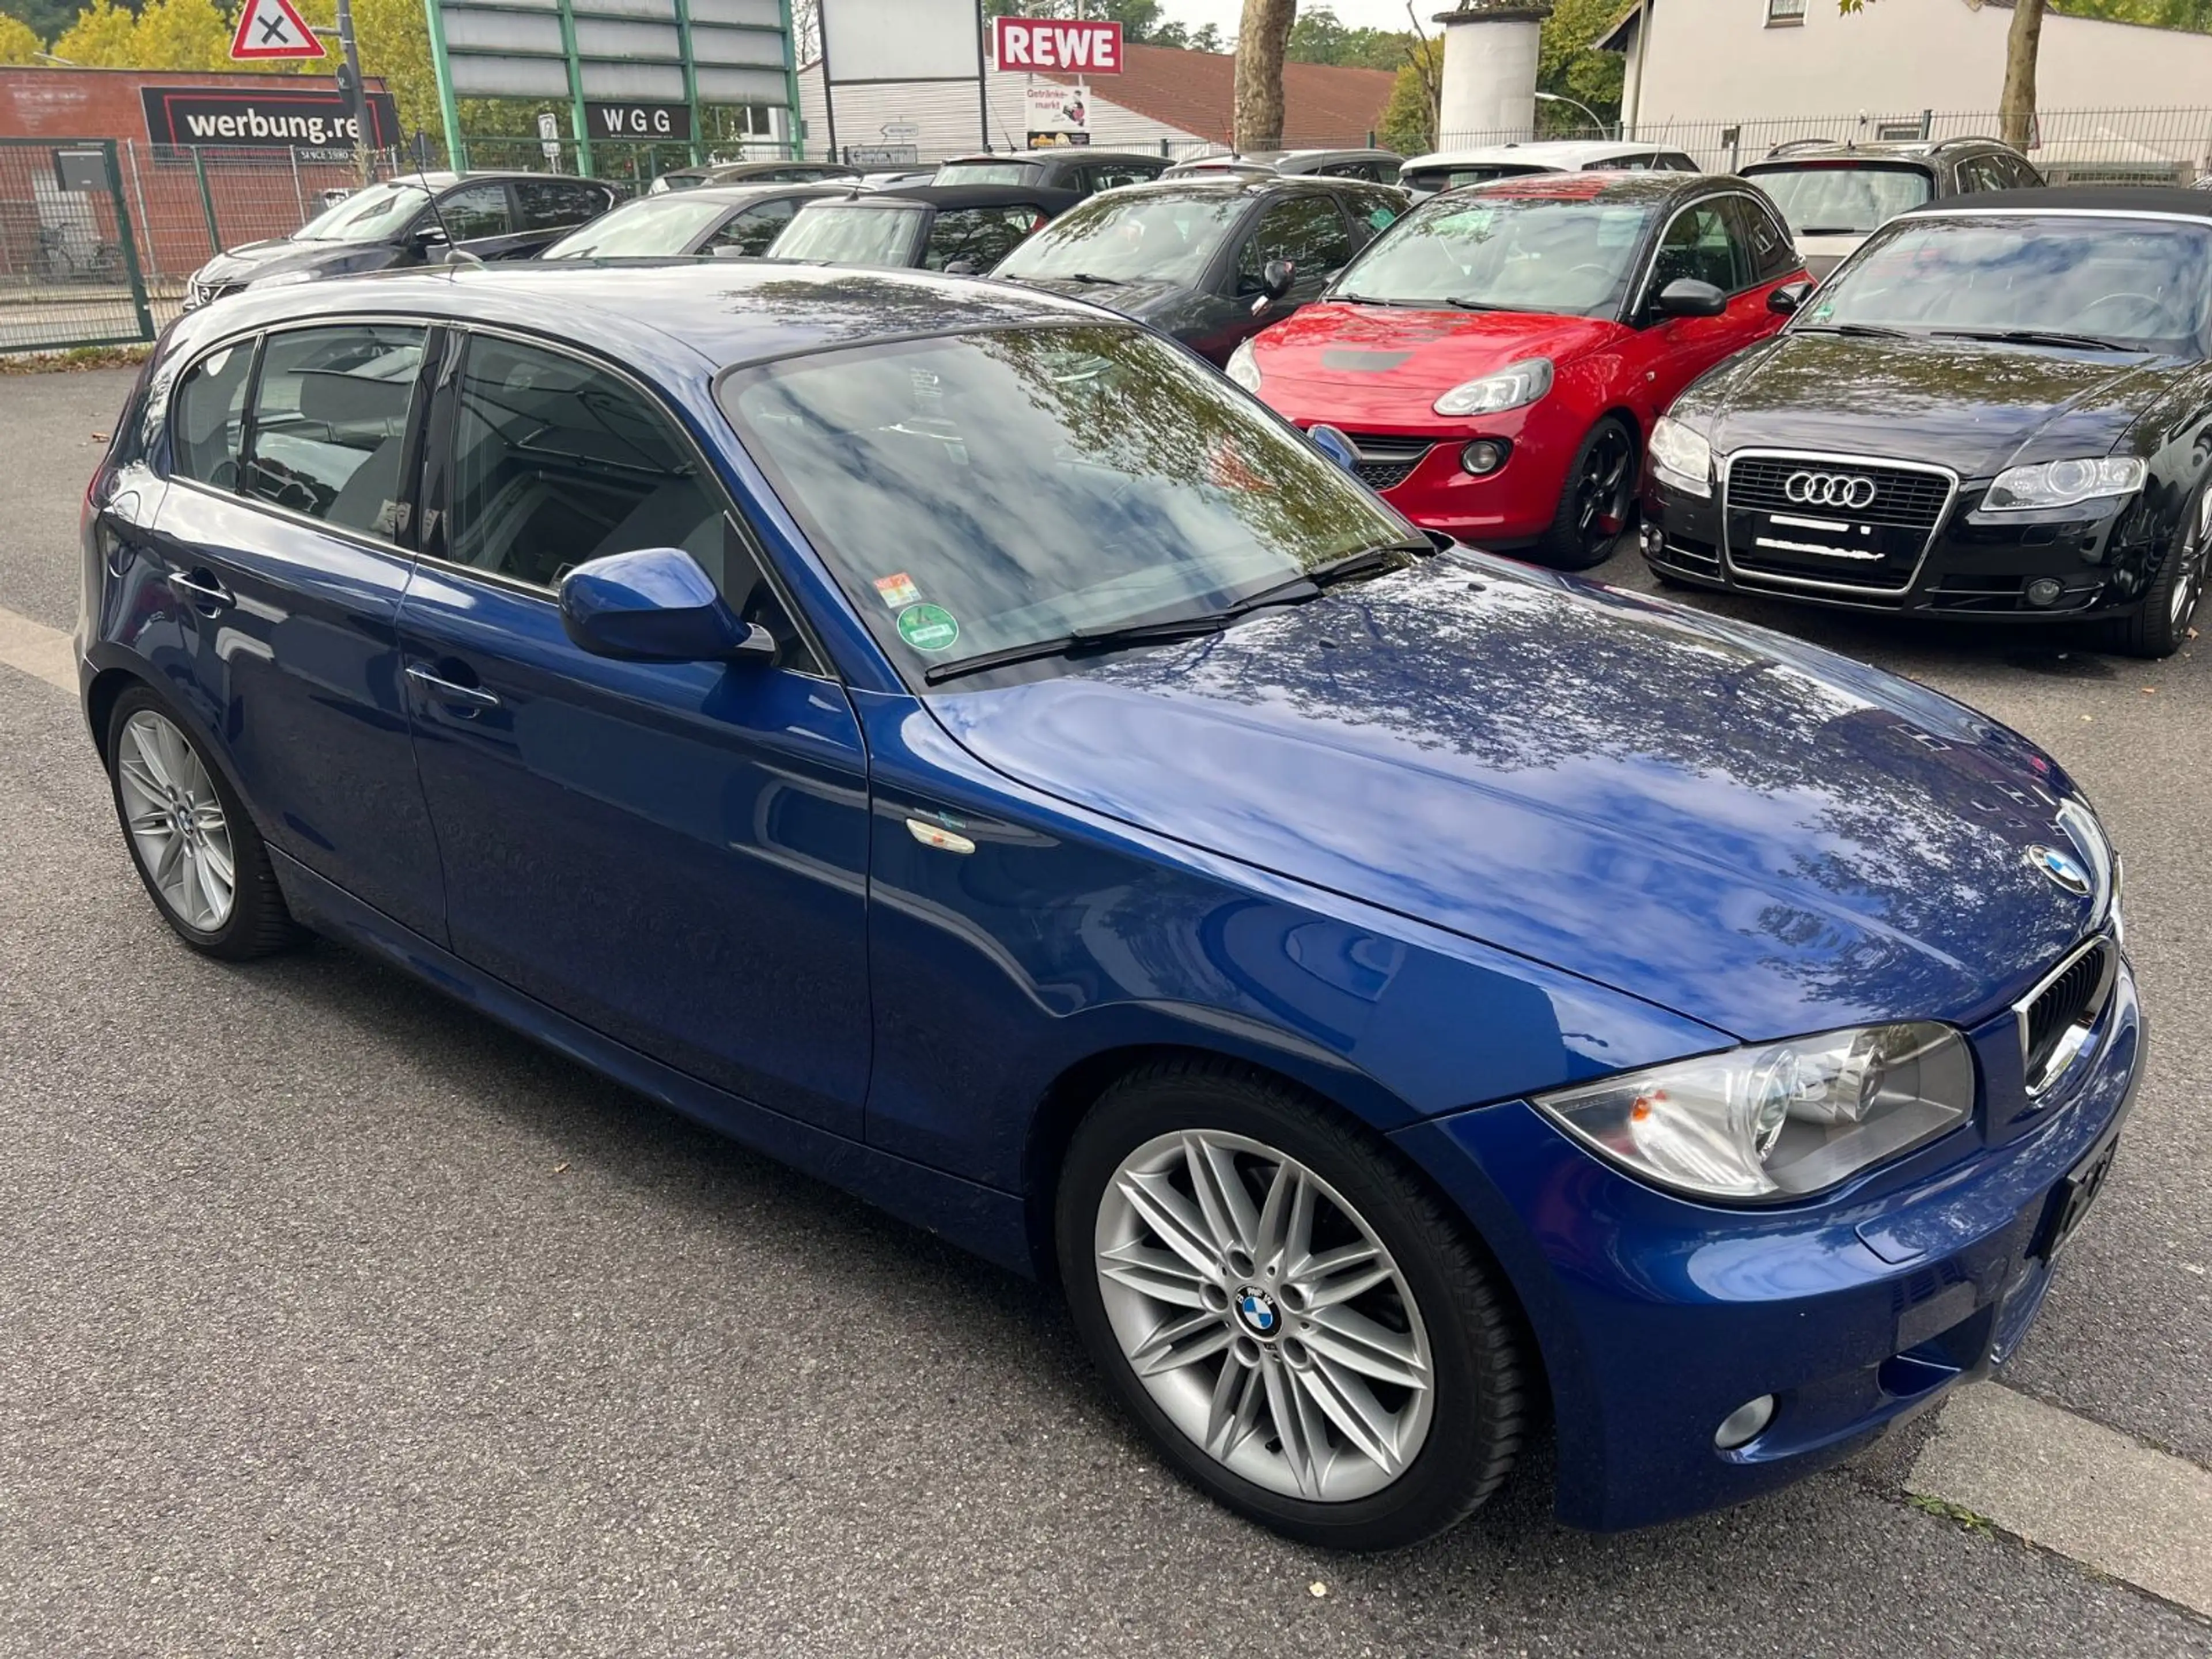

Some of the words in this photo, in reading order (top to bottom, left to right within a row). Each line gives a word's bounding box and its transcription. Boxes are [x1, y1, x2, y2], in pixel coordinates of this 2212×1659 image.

[1005, 26, 1115, 68] REWE
[1035, 101, 1060, 109] markt
[1236, 1287, 1274, 1305] BMW
